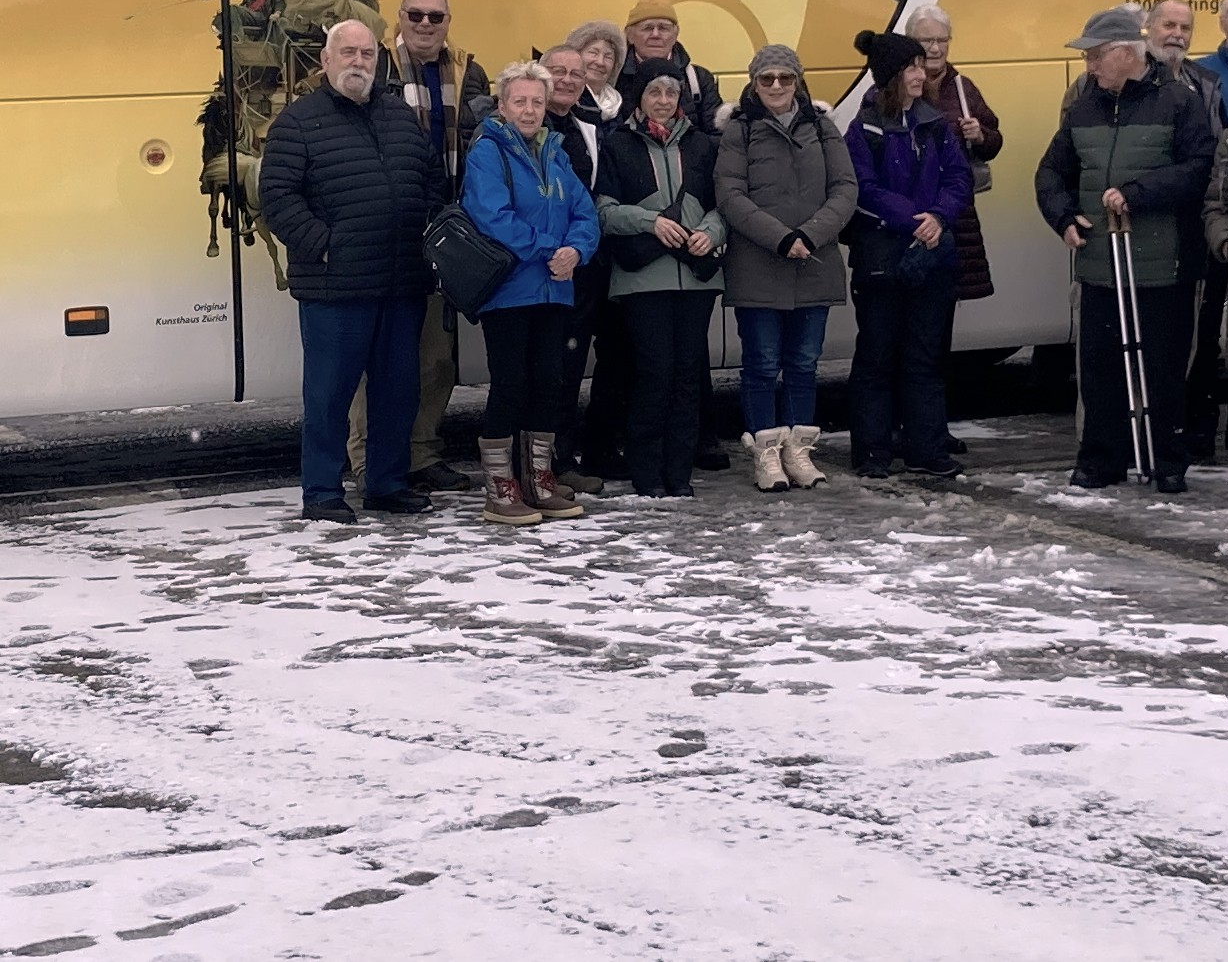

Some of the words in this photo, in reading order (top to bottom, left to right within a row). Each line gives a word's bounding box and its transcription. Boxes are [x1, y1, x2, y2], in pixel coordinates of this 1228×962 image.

[193, 302, 228, 313] Original
[155, 316, 200, 326] Kunsthaus
[201, 313, 228, 324] Zürich
